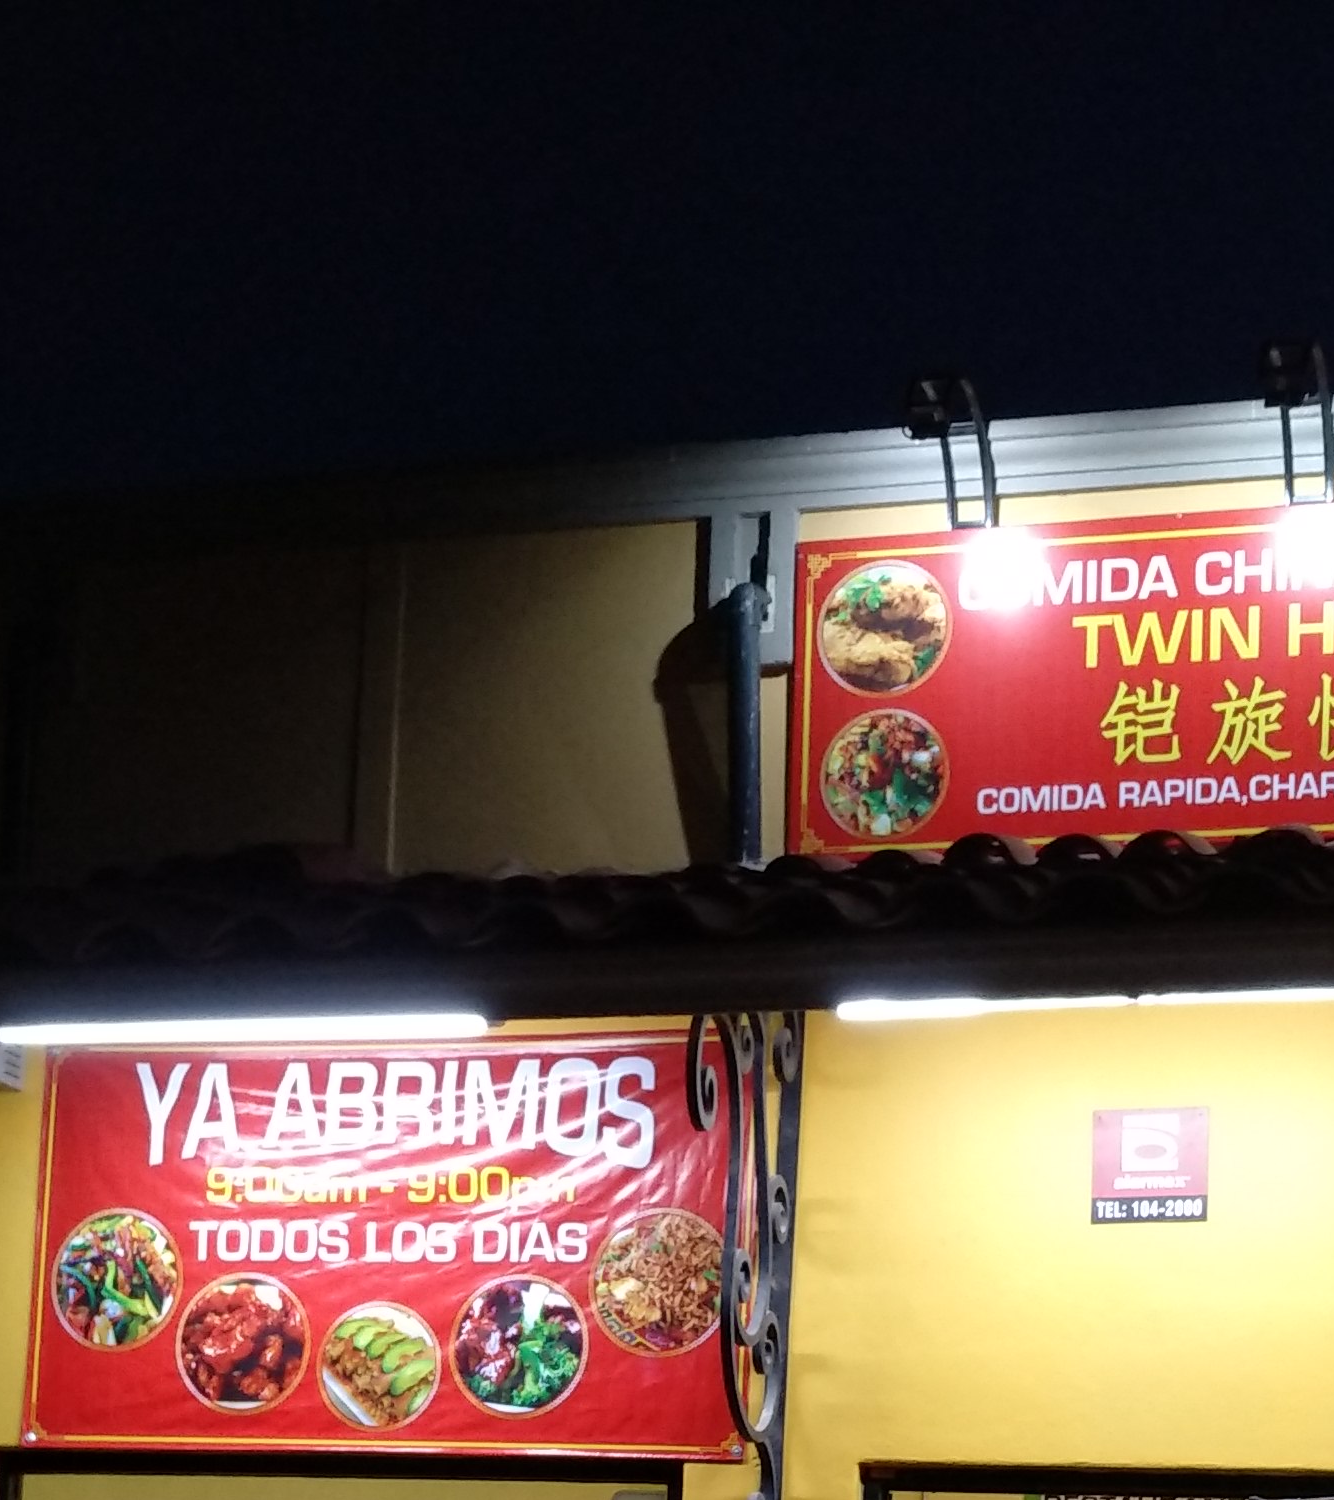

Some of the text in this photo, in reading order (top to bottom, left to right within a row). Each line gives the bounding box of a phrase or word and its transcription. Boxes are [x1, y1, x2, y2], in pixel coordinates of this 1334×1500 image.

[1072, 605, 1261, 668] TWIN
[976, 783, 1106, 816] COMIDA
[135, 1056, 657, 1169] YA ABRIMOS
[1096, 1201, 1127, 1218] TEL:
[190, 1221, 588, 1263] TODOS LOS DIAS
